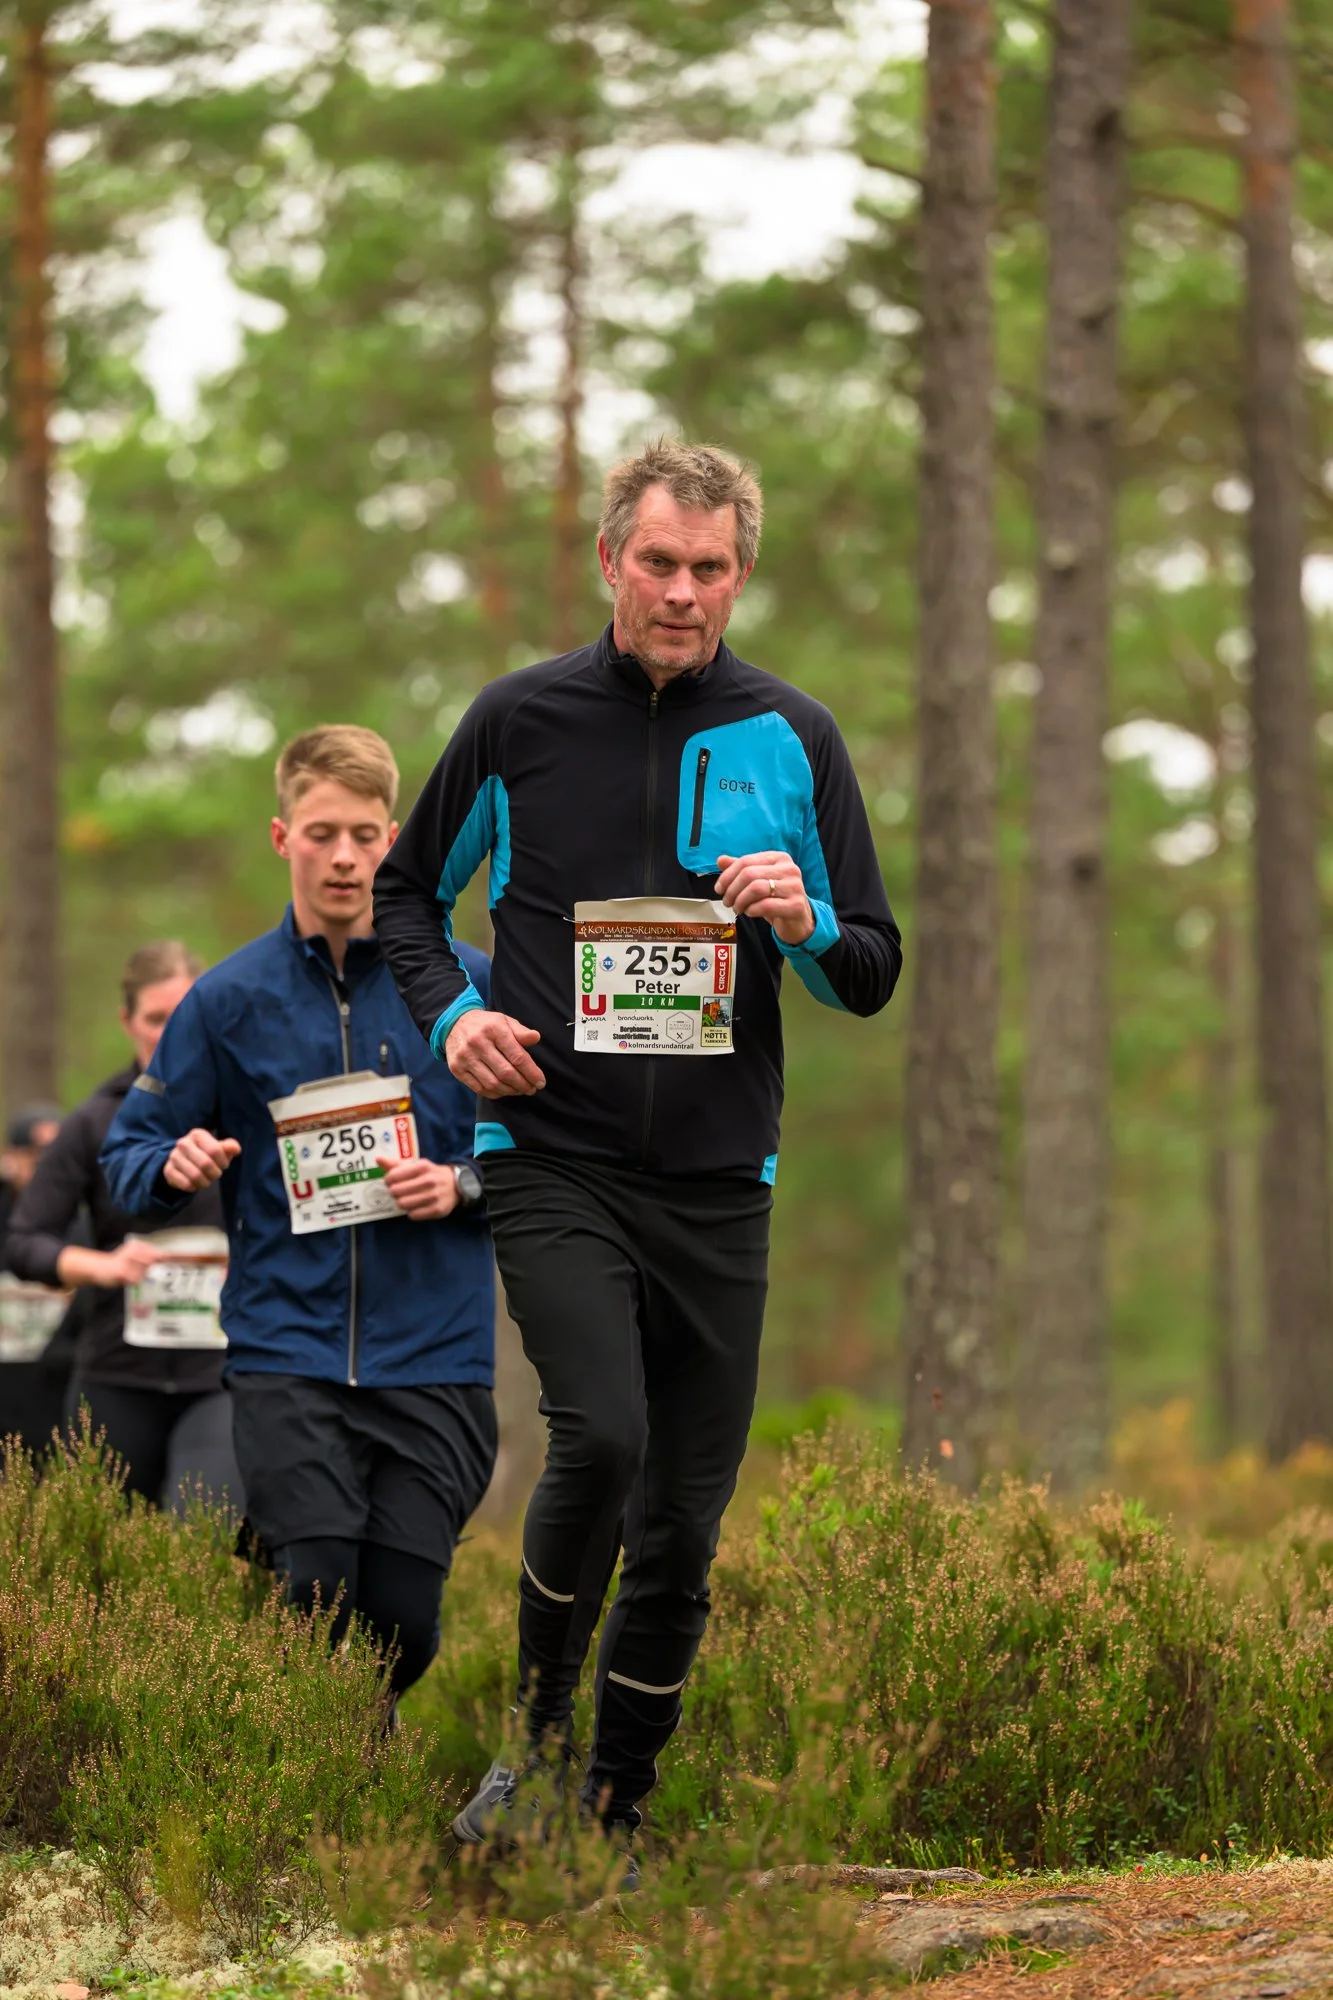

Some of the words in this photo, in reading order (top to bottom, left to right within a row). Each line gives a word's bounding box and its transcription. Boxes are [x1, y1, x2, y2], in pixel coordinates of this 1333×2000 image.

[719, 778, 756, 795] GORE
[581, 943, 597, 994] coop
[625, 945, 691, 976] 255
[718, 962, 727, 990] CIRCLE
[635, 980, 681, 994] Peter
[641, 996, 654, 1006] 10
[661, 996, 675, 1006] KM
[628, 1042, 695, 1050] kolmardsrundantrail
[318, 1125, 376, 1160] 256
[336, 1156, 367, 1173] Carl
